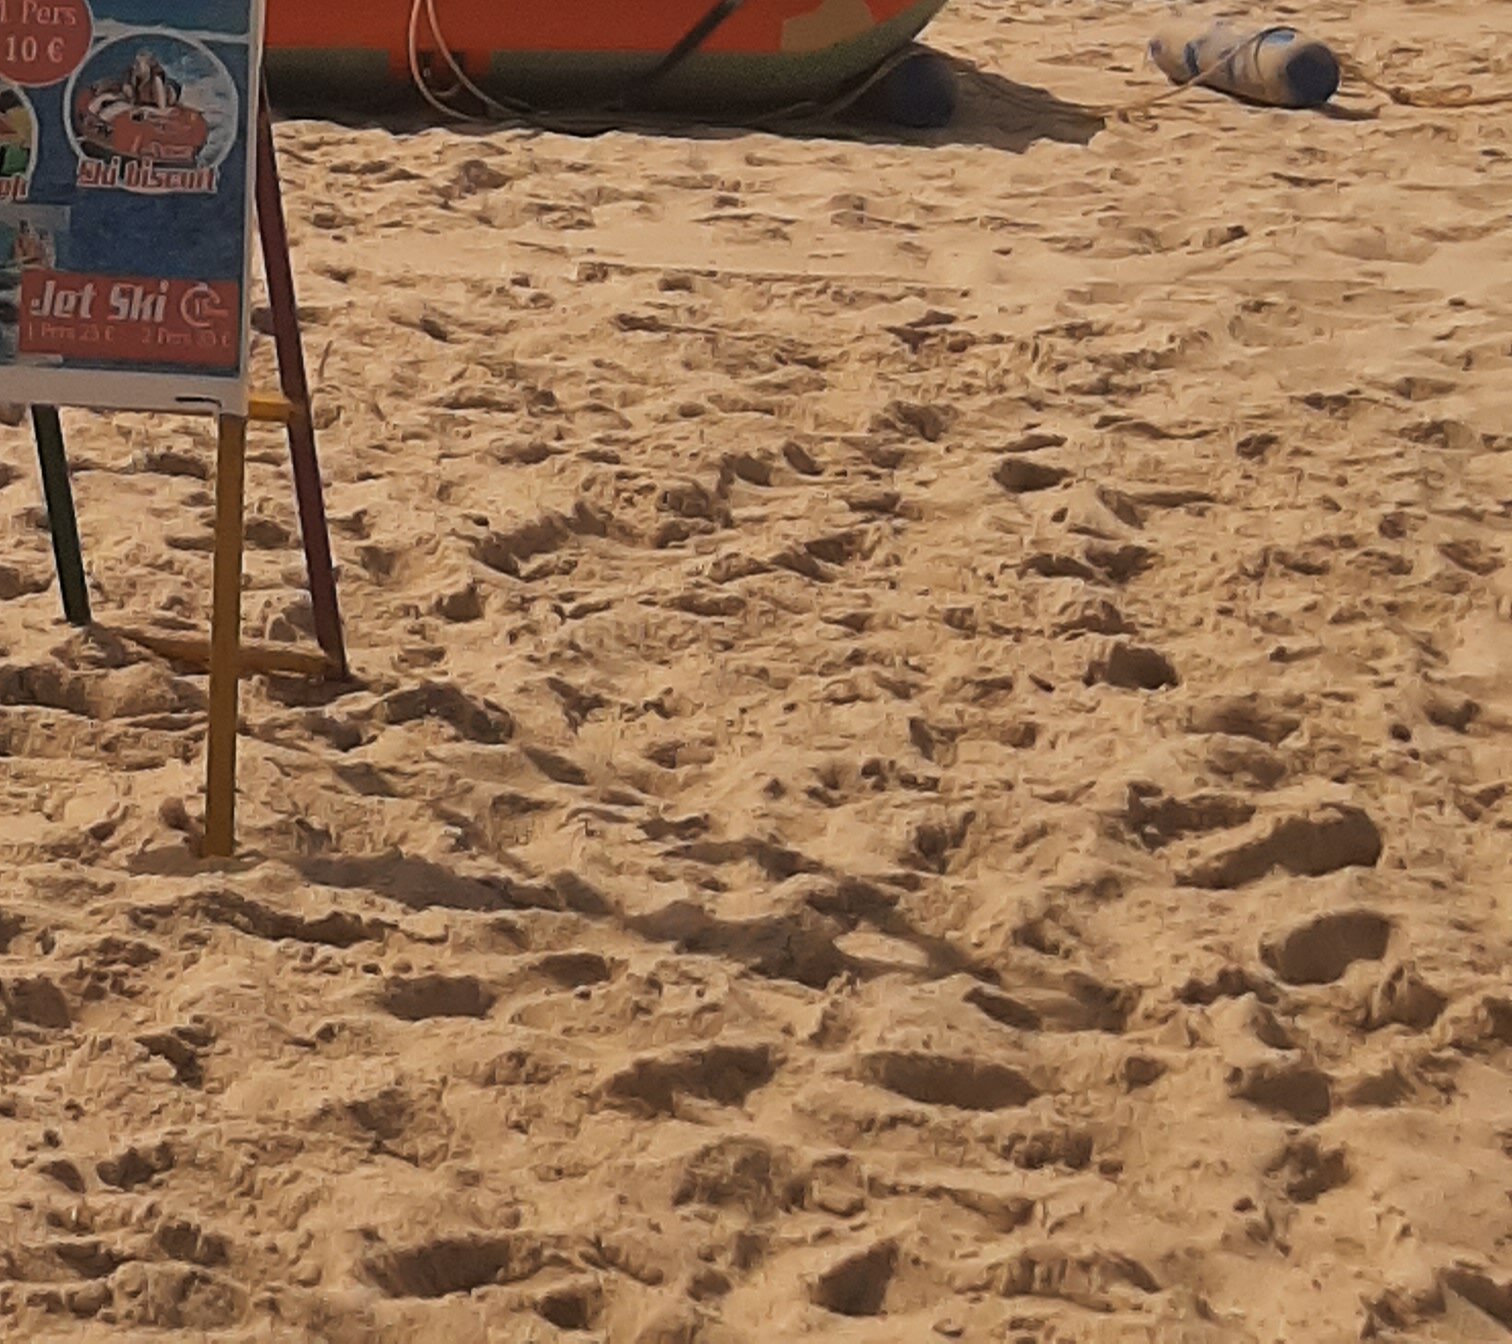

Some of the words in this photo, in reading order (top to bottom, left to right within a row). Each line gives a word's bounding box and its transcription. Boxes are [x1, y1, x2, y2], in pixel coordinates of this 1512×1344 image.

[22, 0, 77, 25] Pers
[5, 37, 37, 61] 10
[47, 37, 66, 61] €
[31, 280, 97, 319] Jet
[107, 279, 170, 323] Ski
